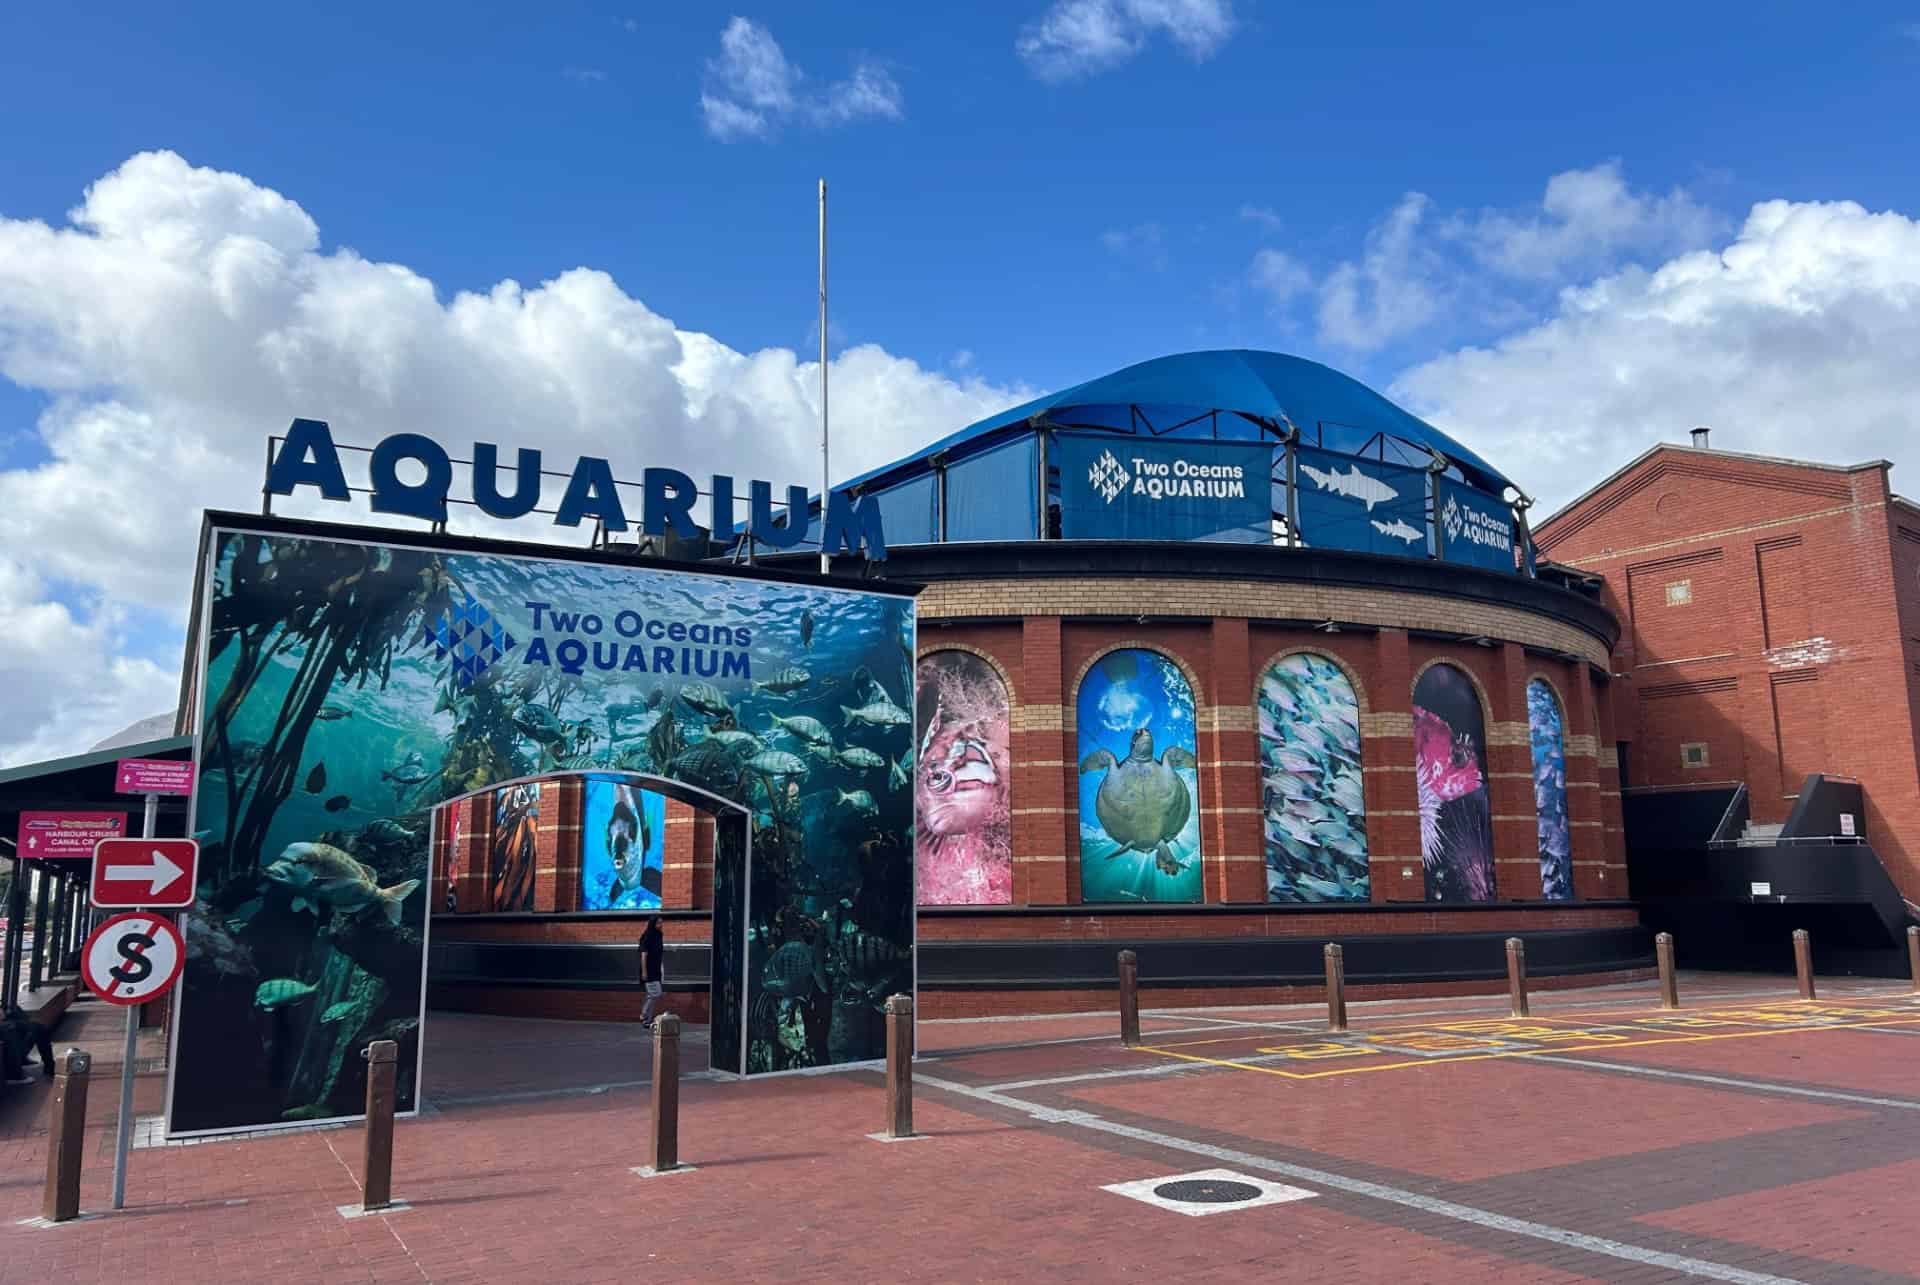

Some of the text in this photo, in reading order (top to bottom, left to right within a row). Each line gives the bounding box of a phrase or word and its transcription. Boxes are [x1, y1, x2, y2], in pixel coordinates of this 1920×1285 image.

[1131, 458, 1243, 479] Two Oceans
[269, 417, 888, 562] AQUARIUM
[1132, 477, 1245, 499] AQUARIUM
[1462, 504, 1509, 535] Two Oceans
[1463, 522, 1511, 552] AQUARIUM
[525, 601, 751, 647] Two Oceans
[522, 637, 751, 679] AQUARIUM
